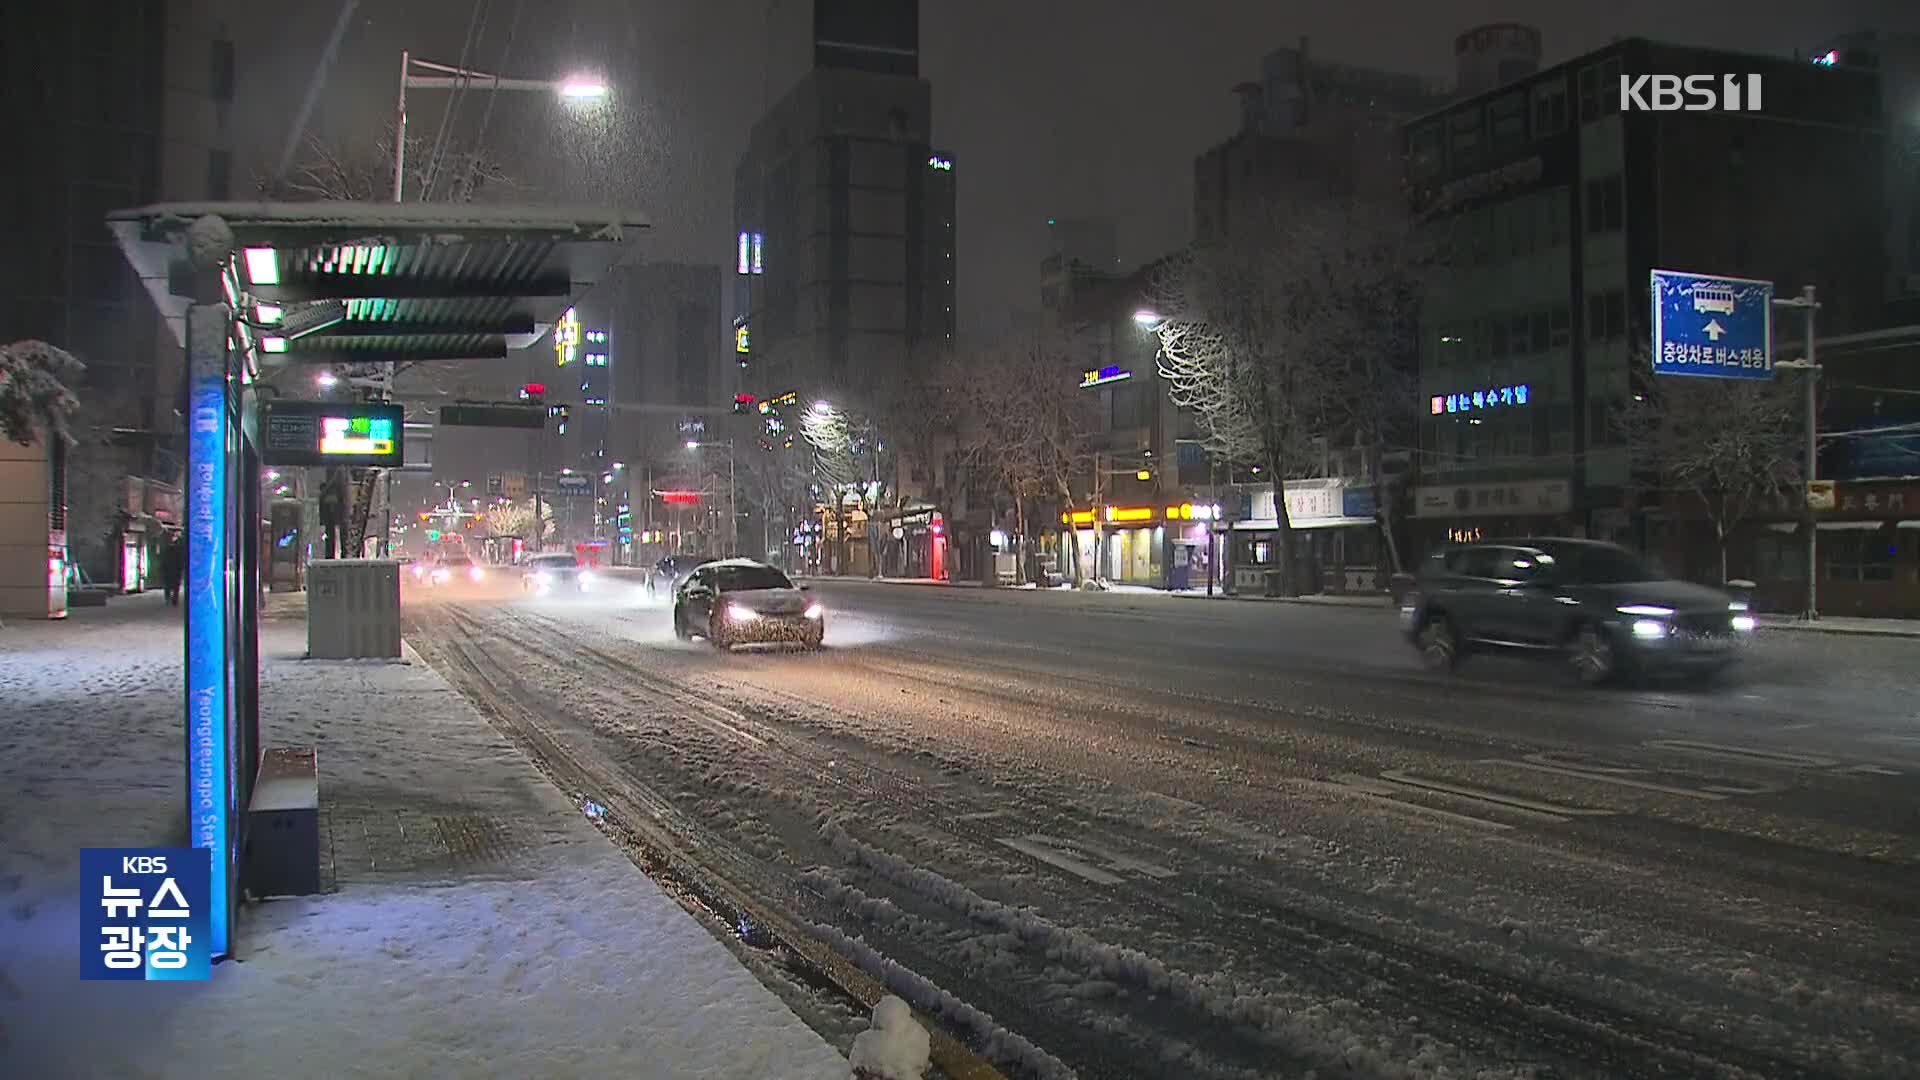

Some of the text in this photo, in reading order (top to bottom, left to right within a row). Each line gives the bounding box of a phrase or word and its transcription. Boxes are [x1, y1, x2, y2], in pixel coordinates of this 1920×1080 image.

[1663, 341, 1765, 369] 중앙차로 버스전용
[196, 685, 216, 809] Yeongdeungpo
